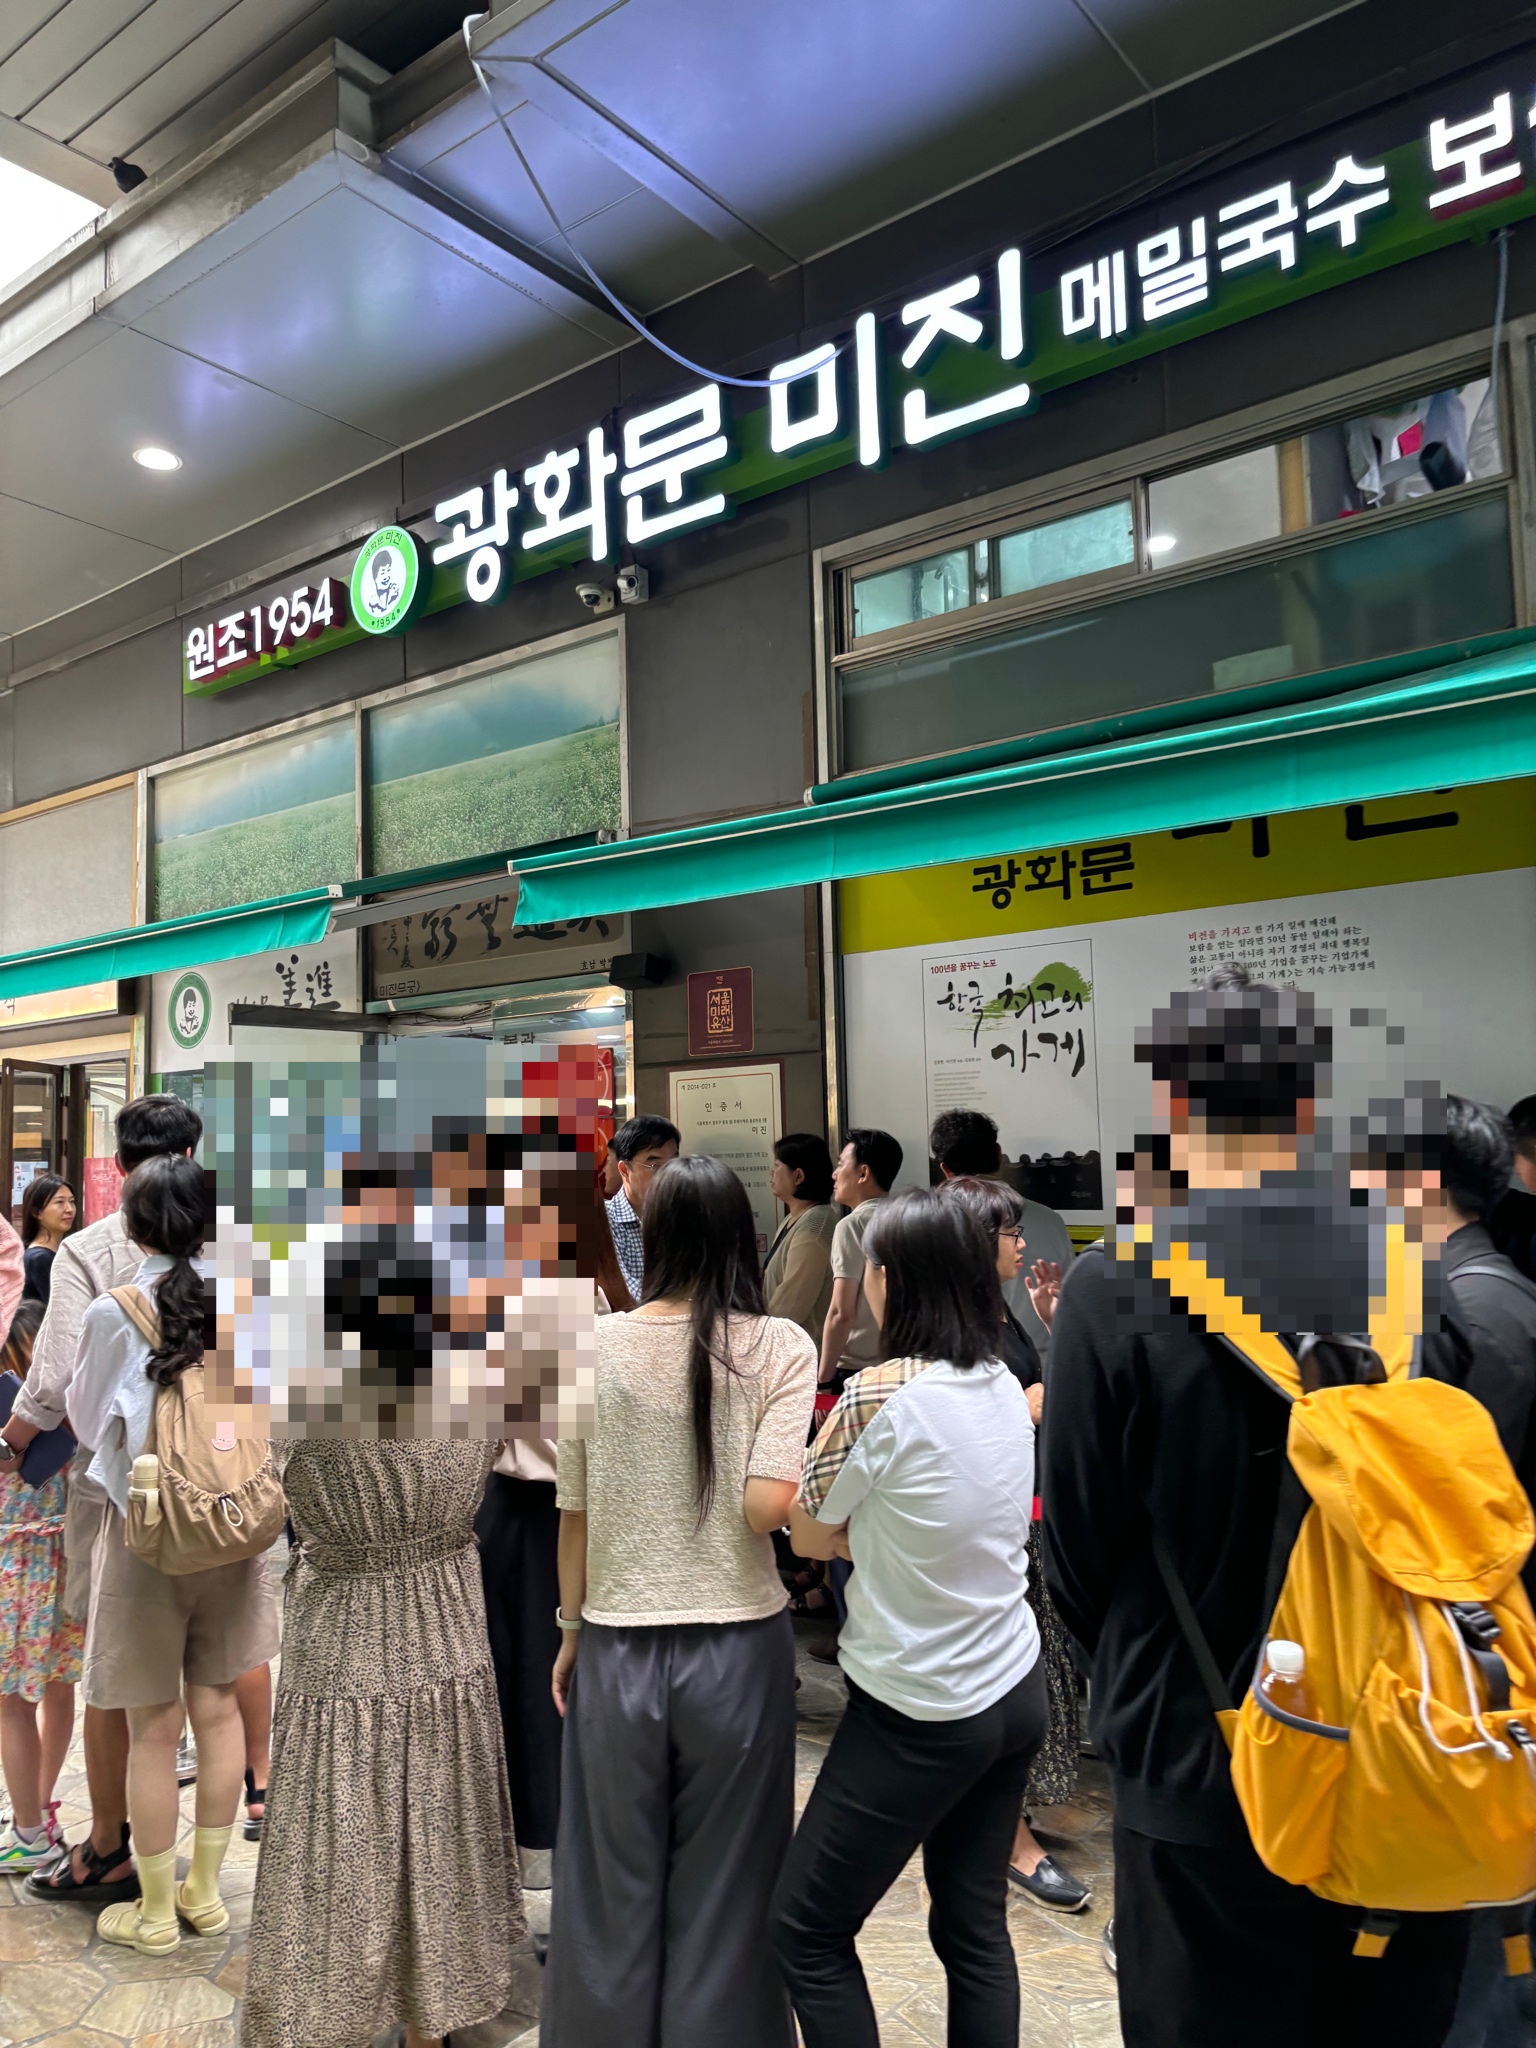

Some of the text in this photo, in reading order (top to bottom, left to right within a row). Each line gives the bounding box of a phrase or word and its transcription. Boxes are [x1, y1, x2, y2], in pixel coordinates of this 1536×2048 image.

[186, 91, 1536, 681] 원조1954 광화문 미진 메밀국수 보
[385, 531, 403, 546] 미진
[376, 612, 396, 629] 1954
[972, 842, 1135, 910] 광화문
[1221, 926, 1251, 937] 가지고
[1254, 925, 1263, 934] 한
[1266, 922, 1284, 932] 가지
[1189, 942, 1215, 953] 보람을
[1217, 940, 1235, 950] 얻는
[1267, 934, 1286, 944] 50년
[1290, 932, 1307, 942] 동안
[1312, 928, 1338, 939] 일해야
[1343, 926, 1362, 936] 하는
[1189, 955, 1206, 965] 삶은
[1238, 948, 1264, 959] 아니라
[1268, 945, 1285, 955] 자기
[1289, 942, 1316, 953] 경영의
[1320, 940, 1338, 950] 최대
[930, 959, 998, 975] 100년을 꿈꾸는 노포
[1270, 957, 1297, 967] 기업을
[1301, 954, 1328, 965] 꿈꾸는
[1308, 966, 1325, 976] 지속
[710, 991, 730, 1005] 서울
[710, 1004, 731, 1016] 미래
[936, 972, 1083, 1048] 한국 최고의
[710, 1016, 731, 1030] 유산
[991, 1028, 1086, 1078] 가게
[687, 1083, 711, 1091] 2014-021
